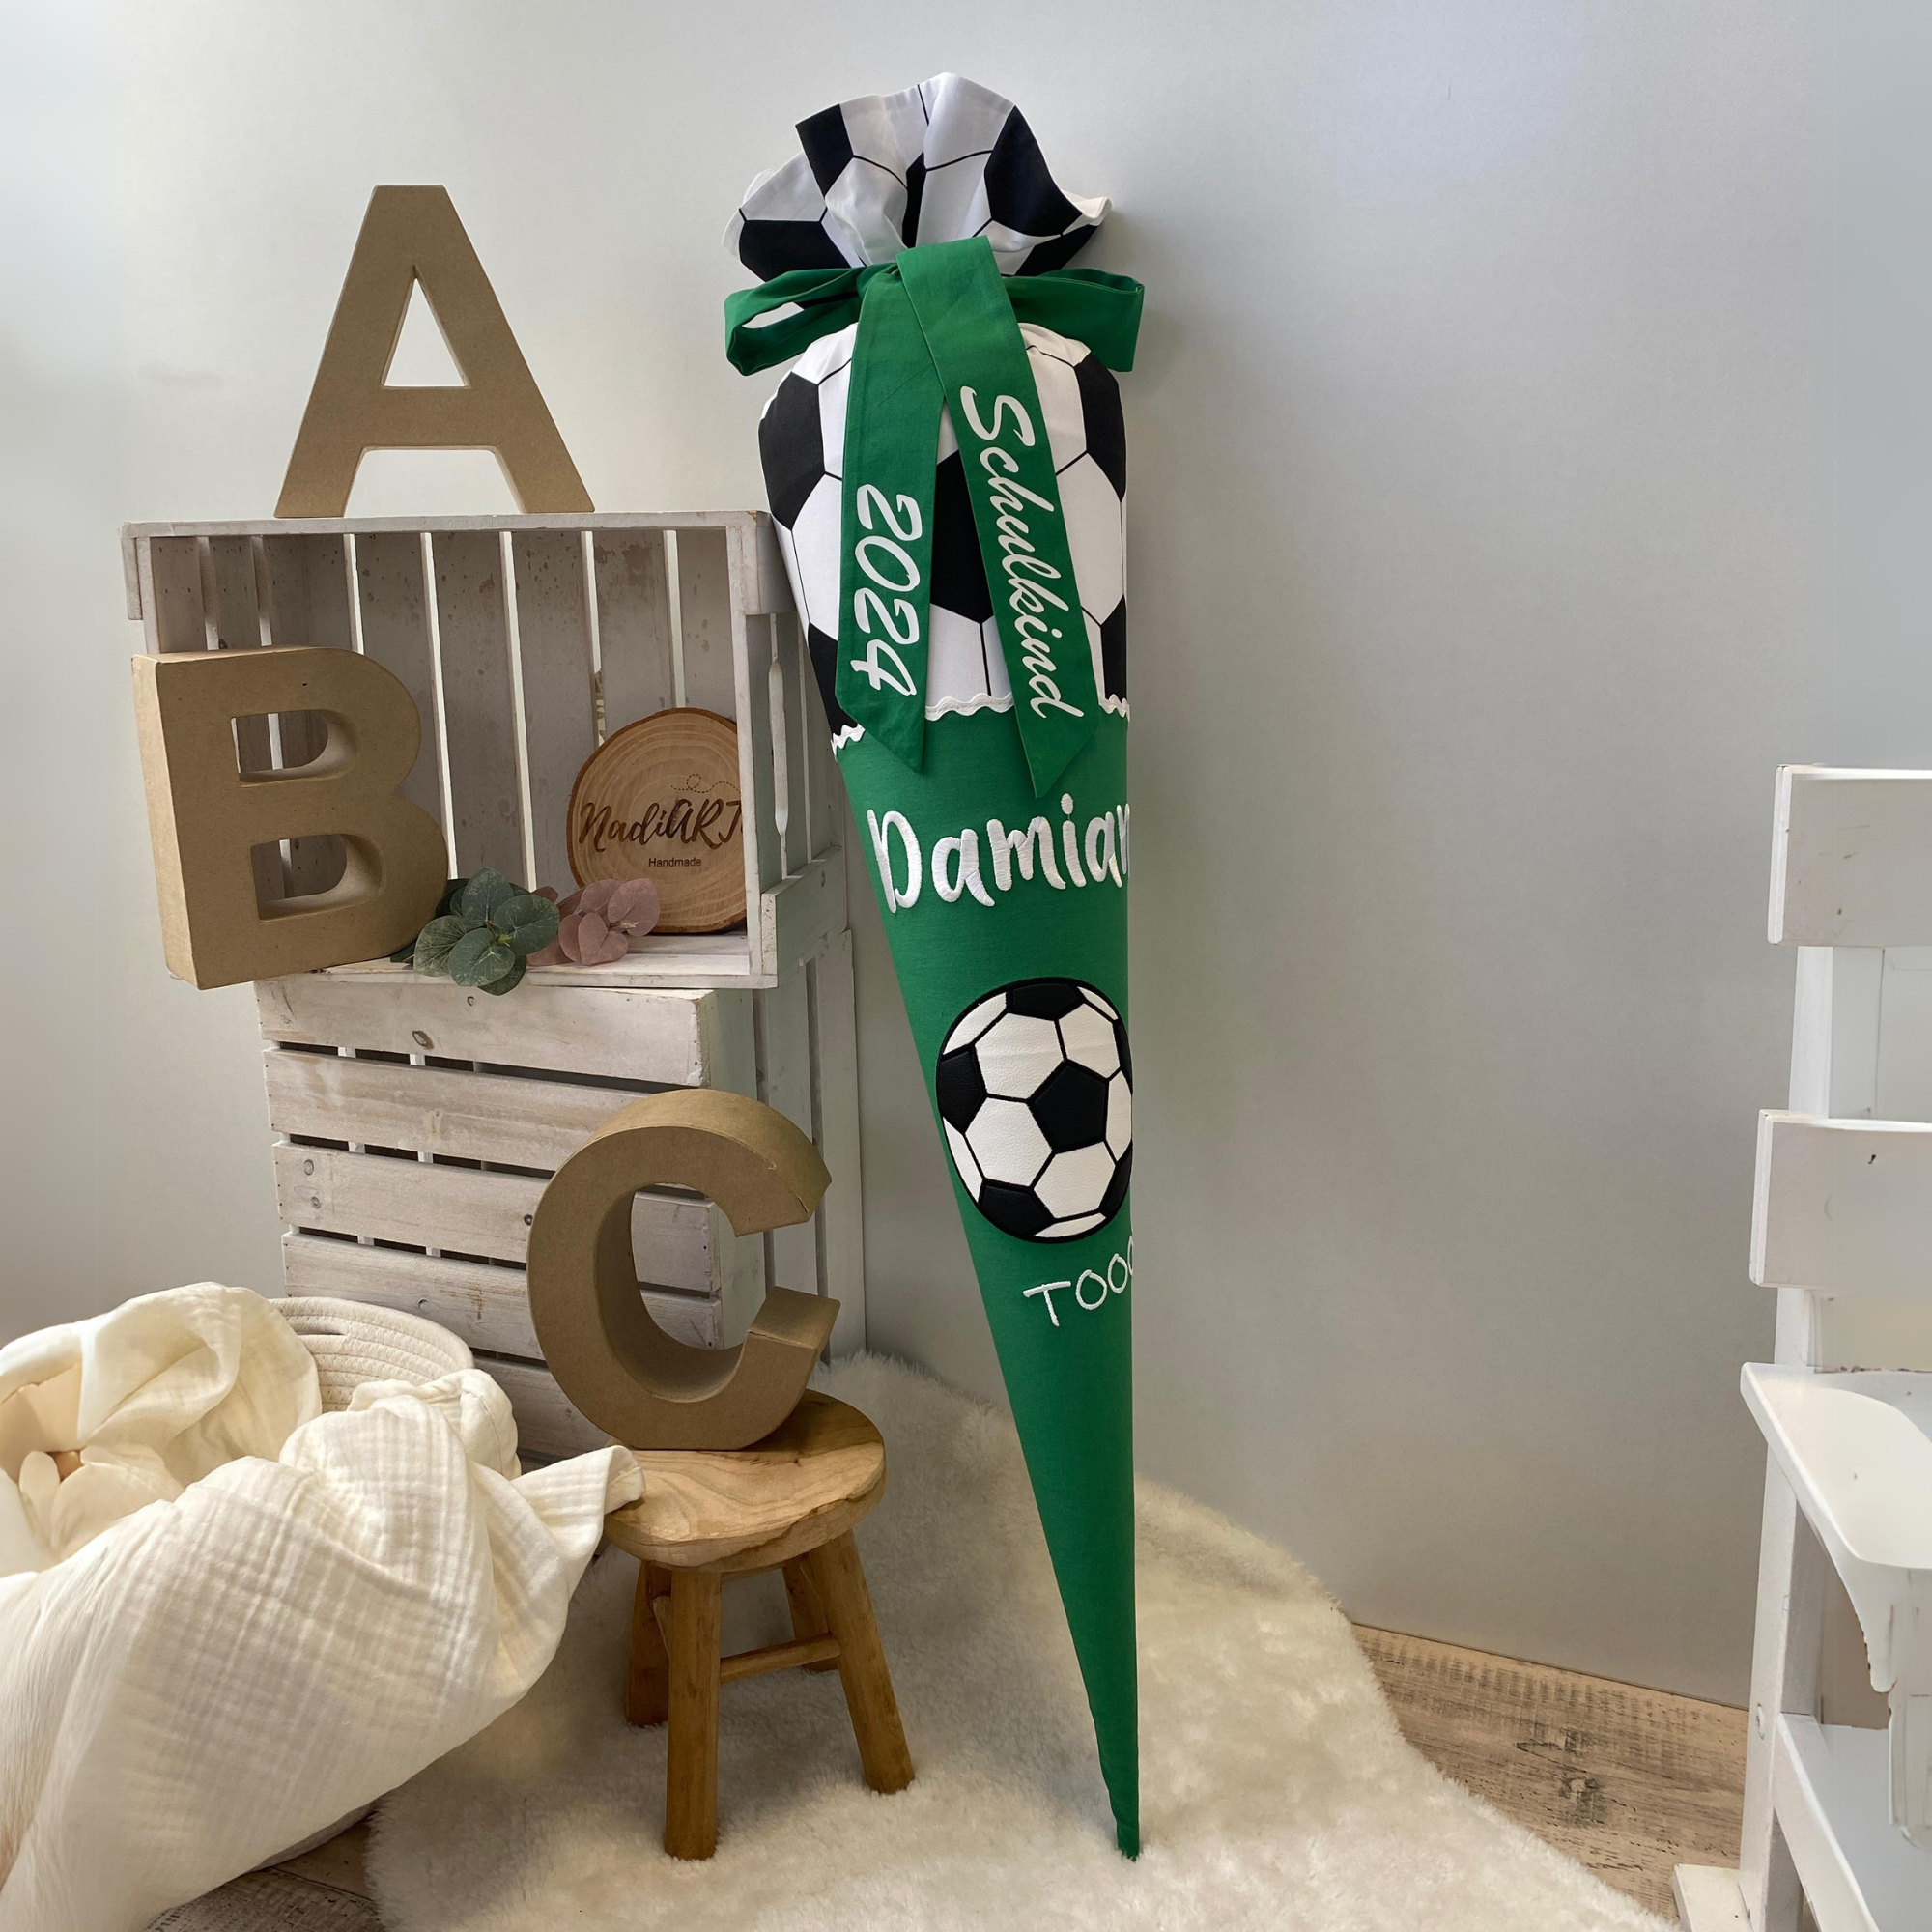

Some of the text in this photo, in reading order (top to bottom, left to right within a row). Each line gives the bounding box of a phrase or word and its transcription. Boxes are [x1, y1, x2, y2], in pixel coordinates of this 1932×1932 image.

[274, 185, 595, 518] A
[850, 483, 923, 696] 2024
[960, 385, 1085, 719] Schulkind
[131, 645, 450, 990] B
[647, 857, 702, 867] Handmade
[526, 1088, 841, 1450] C
